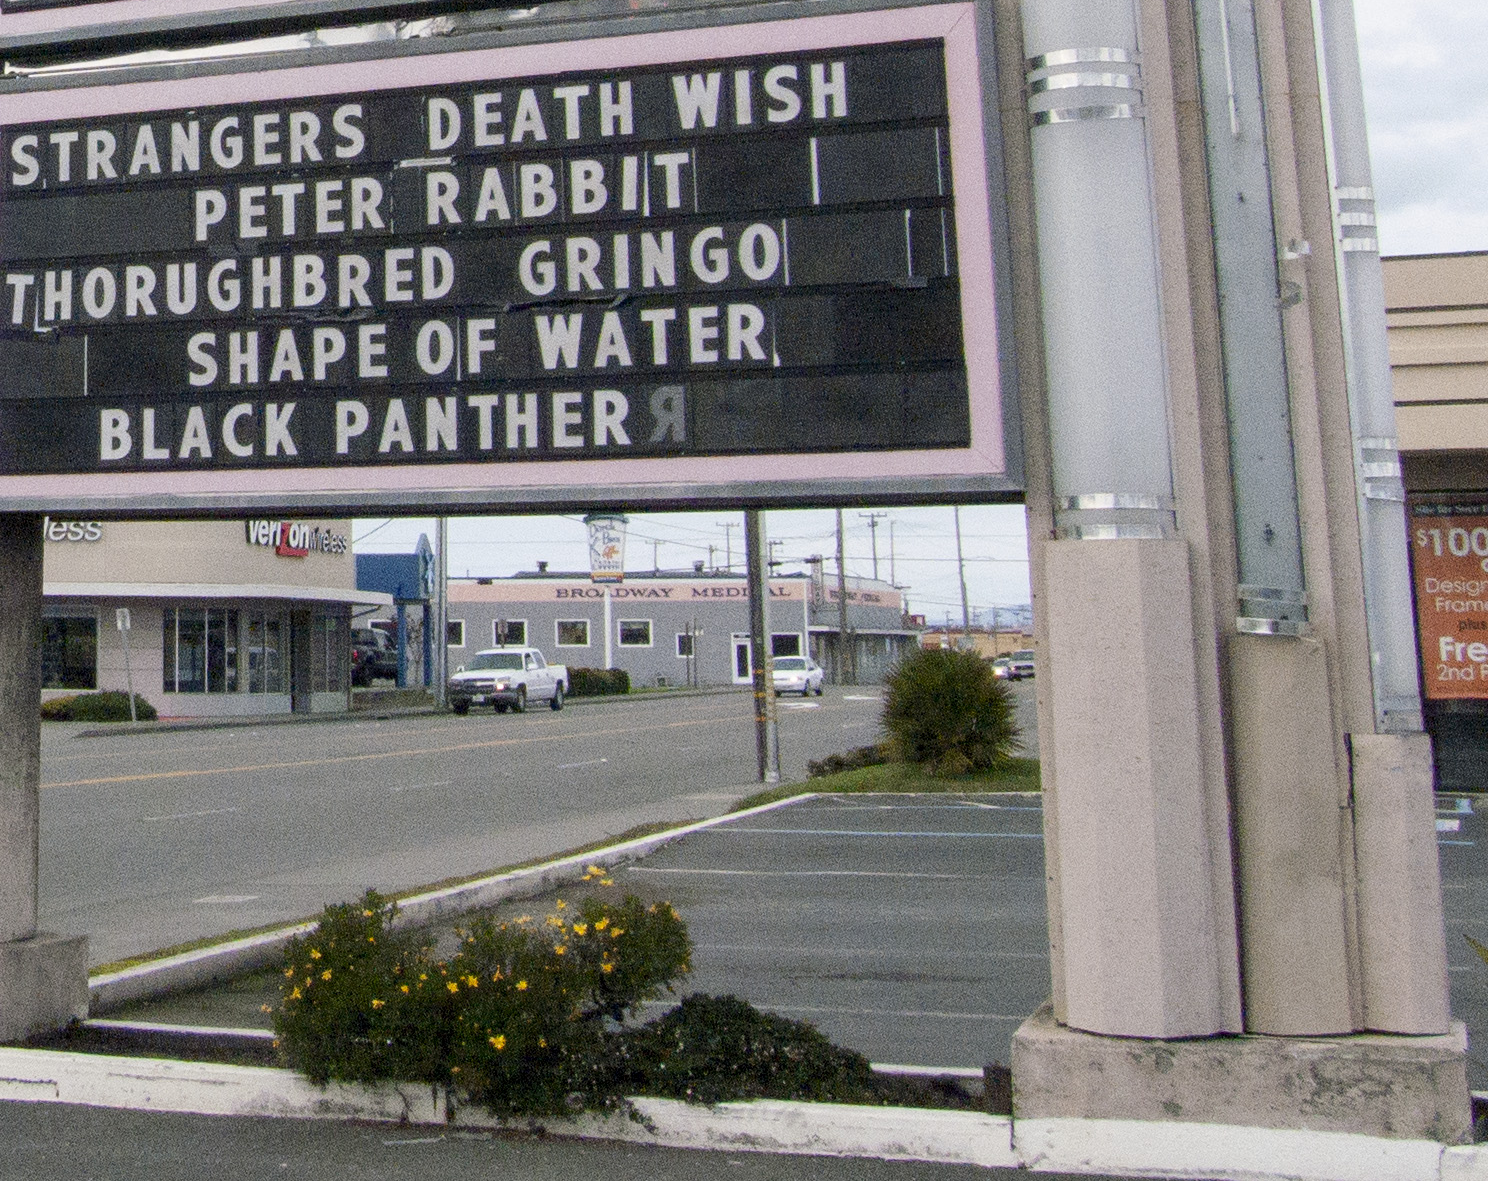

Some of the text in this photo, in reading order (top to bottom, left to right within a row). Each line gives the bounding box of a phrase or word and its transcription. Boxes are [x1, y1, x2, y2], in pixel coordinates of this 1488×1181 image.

[11, 61, 847, 186] STRANGERS DEATH WISH
[195, 152, 689, 242] PETER RABBIT
[6, 223, 780, 325] THORUGHBRED GRINGO
[187, 303, 766, 387] SHAPE OF WATER
[100, 389, 631, 461] BLACK PANTHER
[246, 520, 309, 557] verizon
[1416, 526, 1488, 556] $100
[691, 586, 792, 598] MEDIAL
[1458, 618, 1488, 632] plus
[1436, 663, 1475, 681] 2nd
